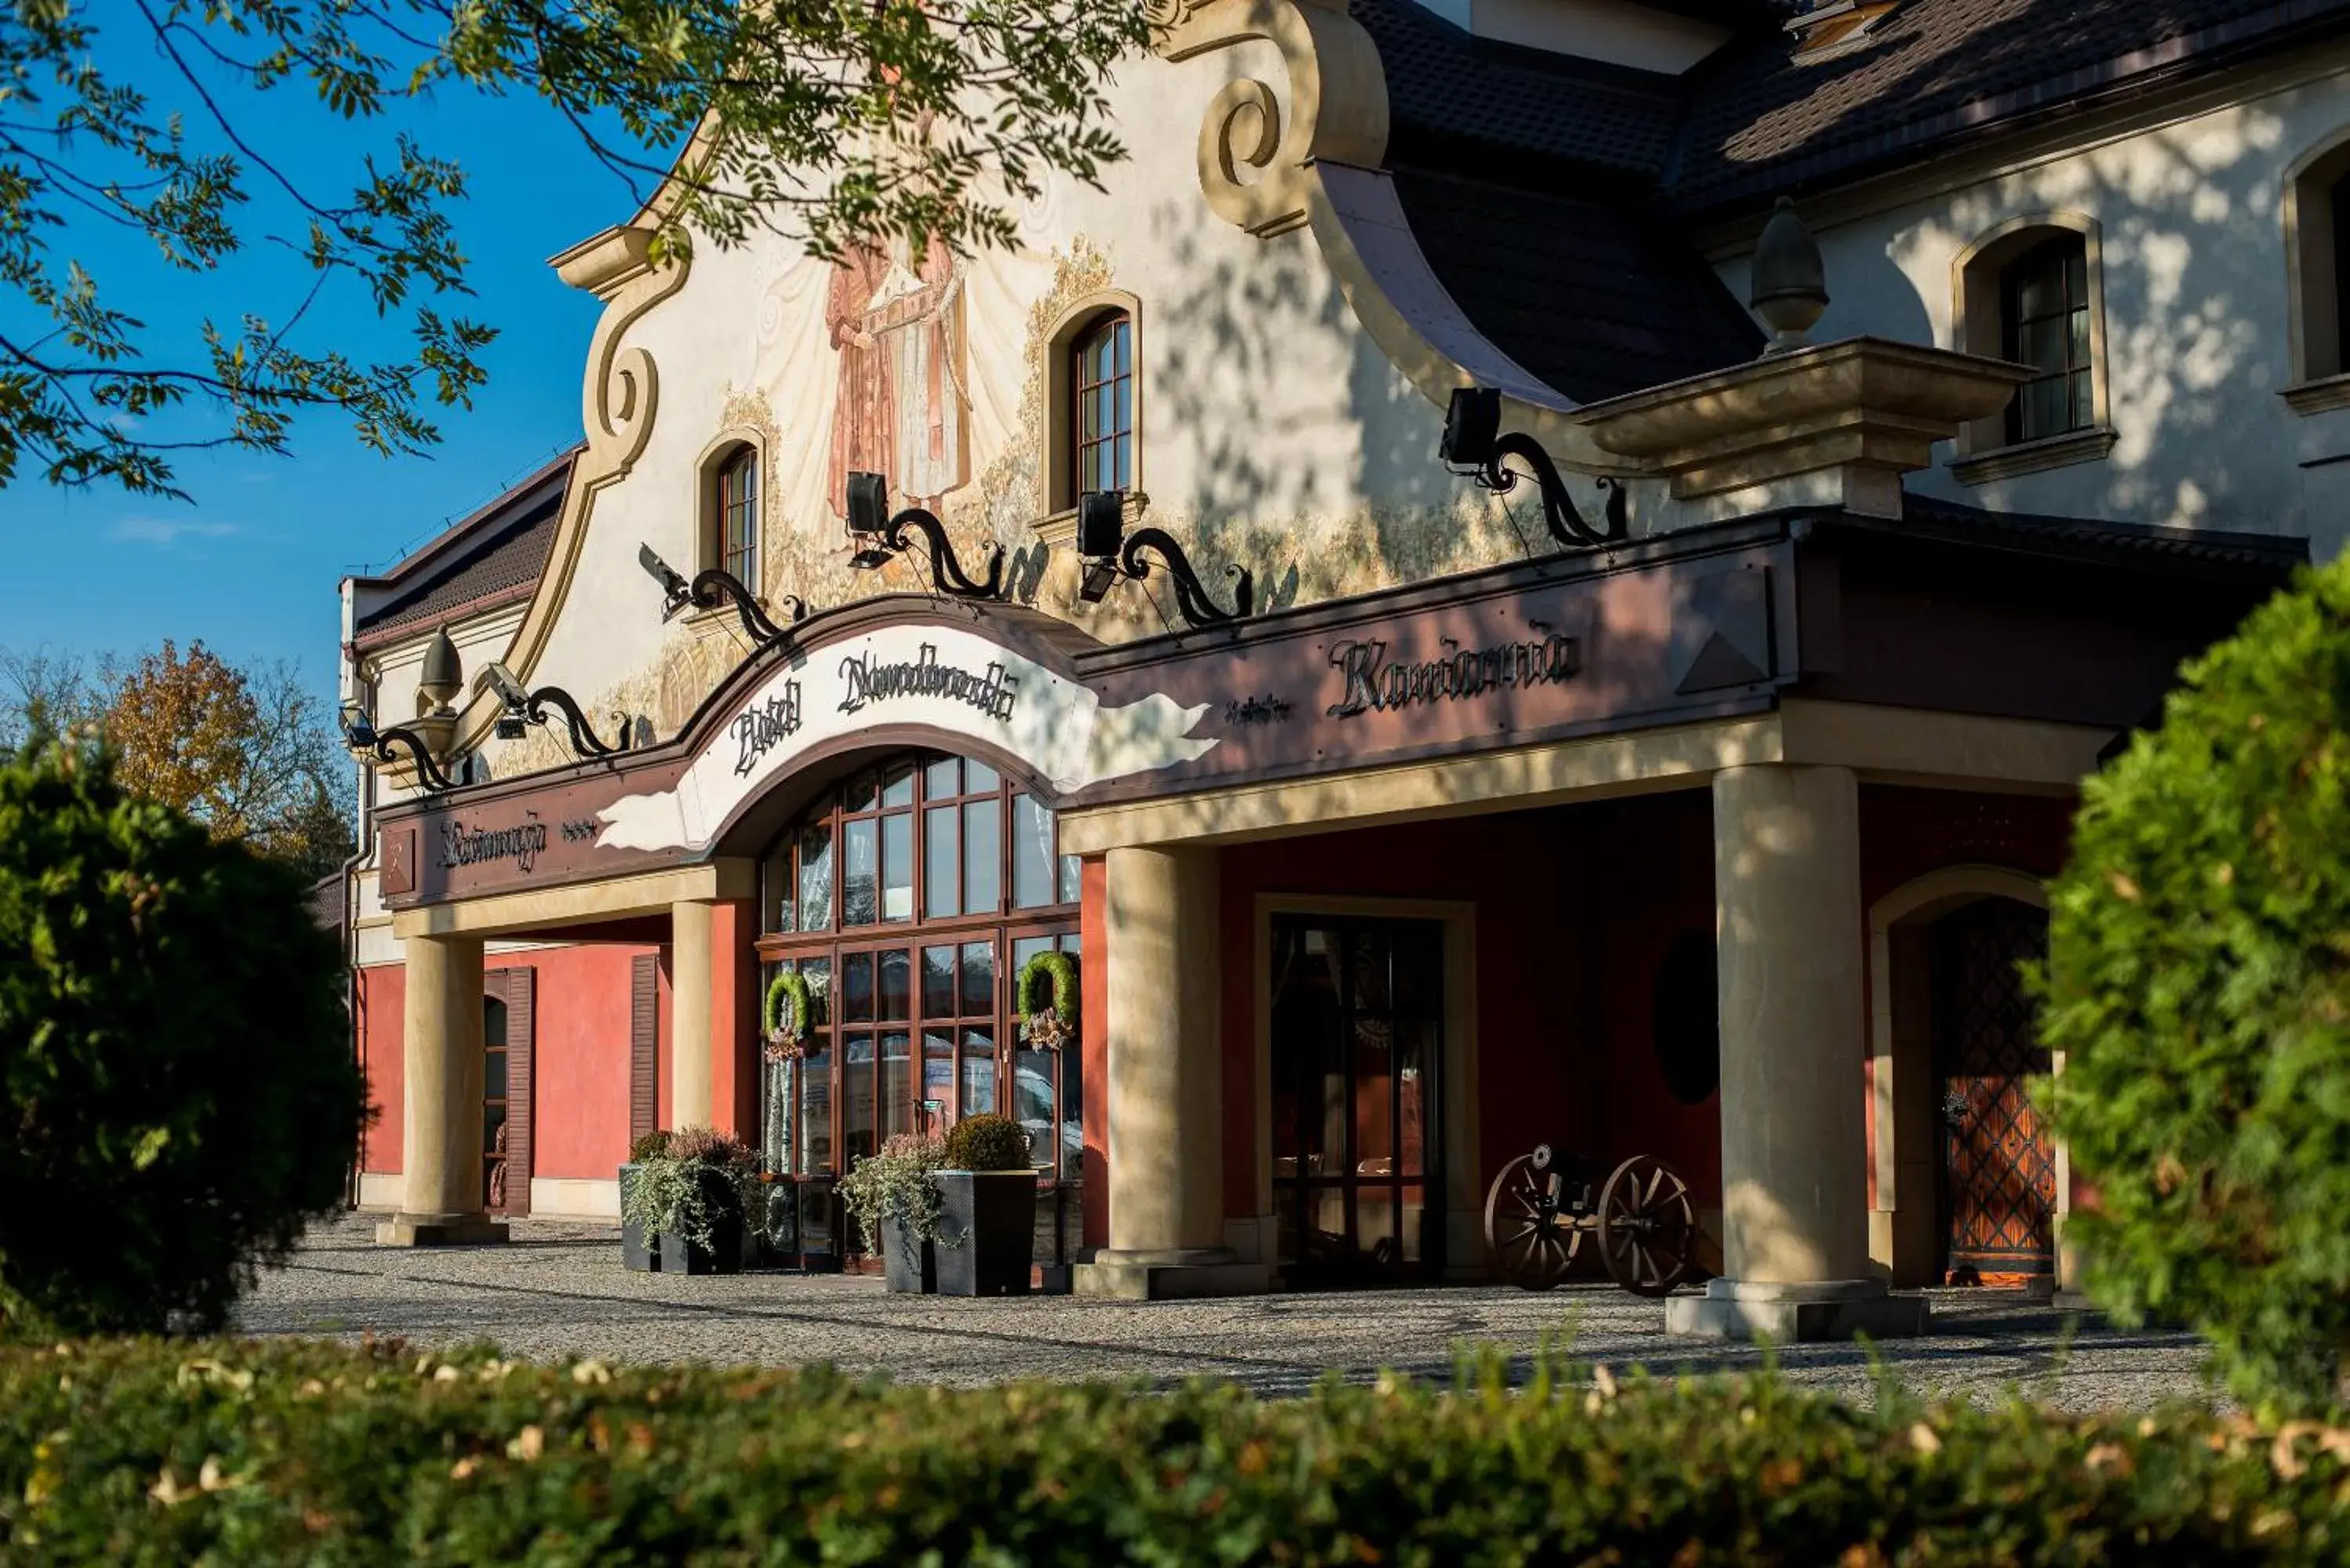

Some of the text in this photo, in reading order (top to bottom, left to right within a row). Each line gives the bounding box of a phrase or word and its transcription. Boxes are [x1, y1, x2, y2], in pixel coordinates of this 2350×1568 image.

[730, 642, 1019, 779] Hotel Nowodworski
[1327, 619, 1576, 720] Kawiarnia
